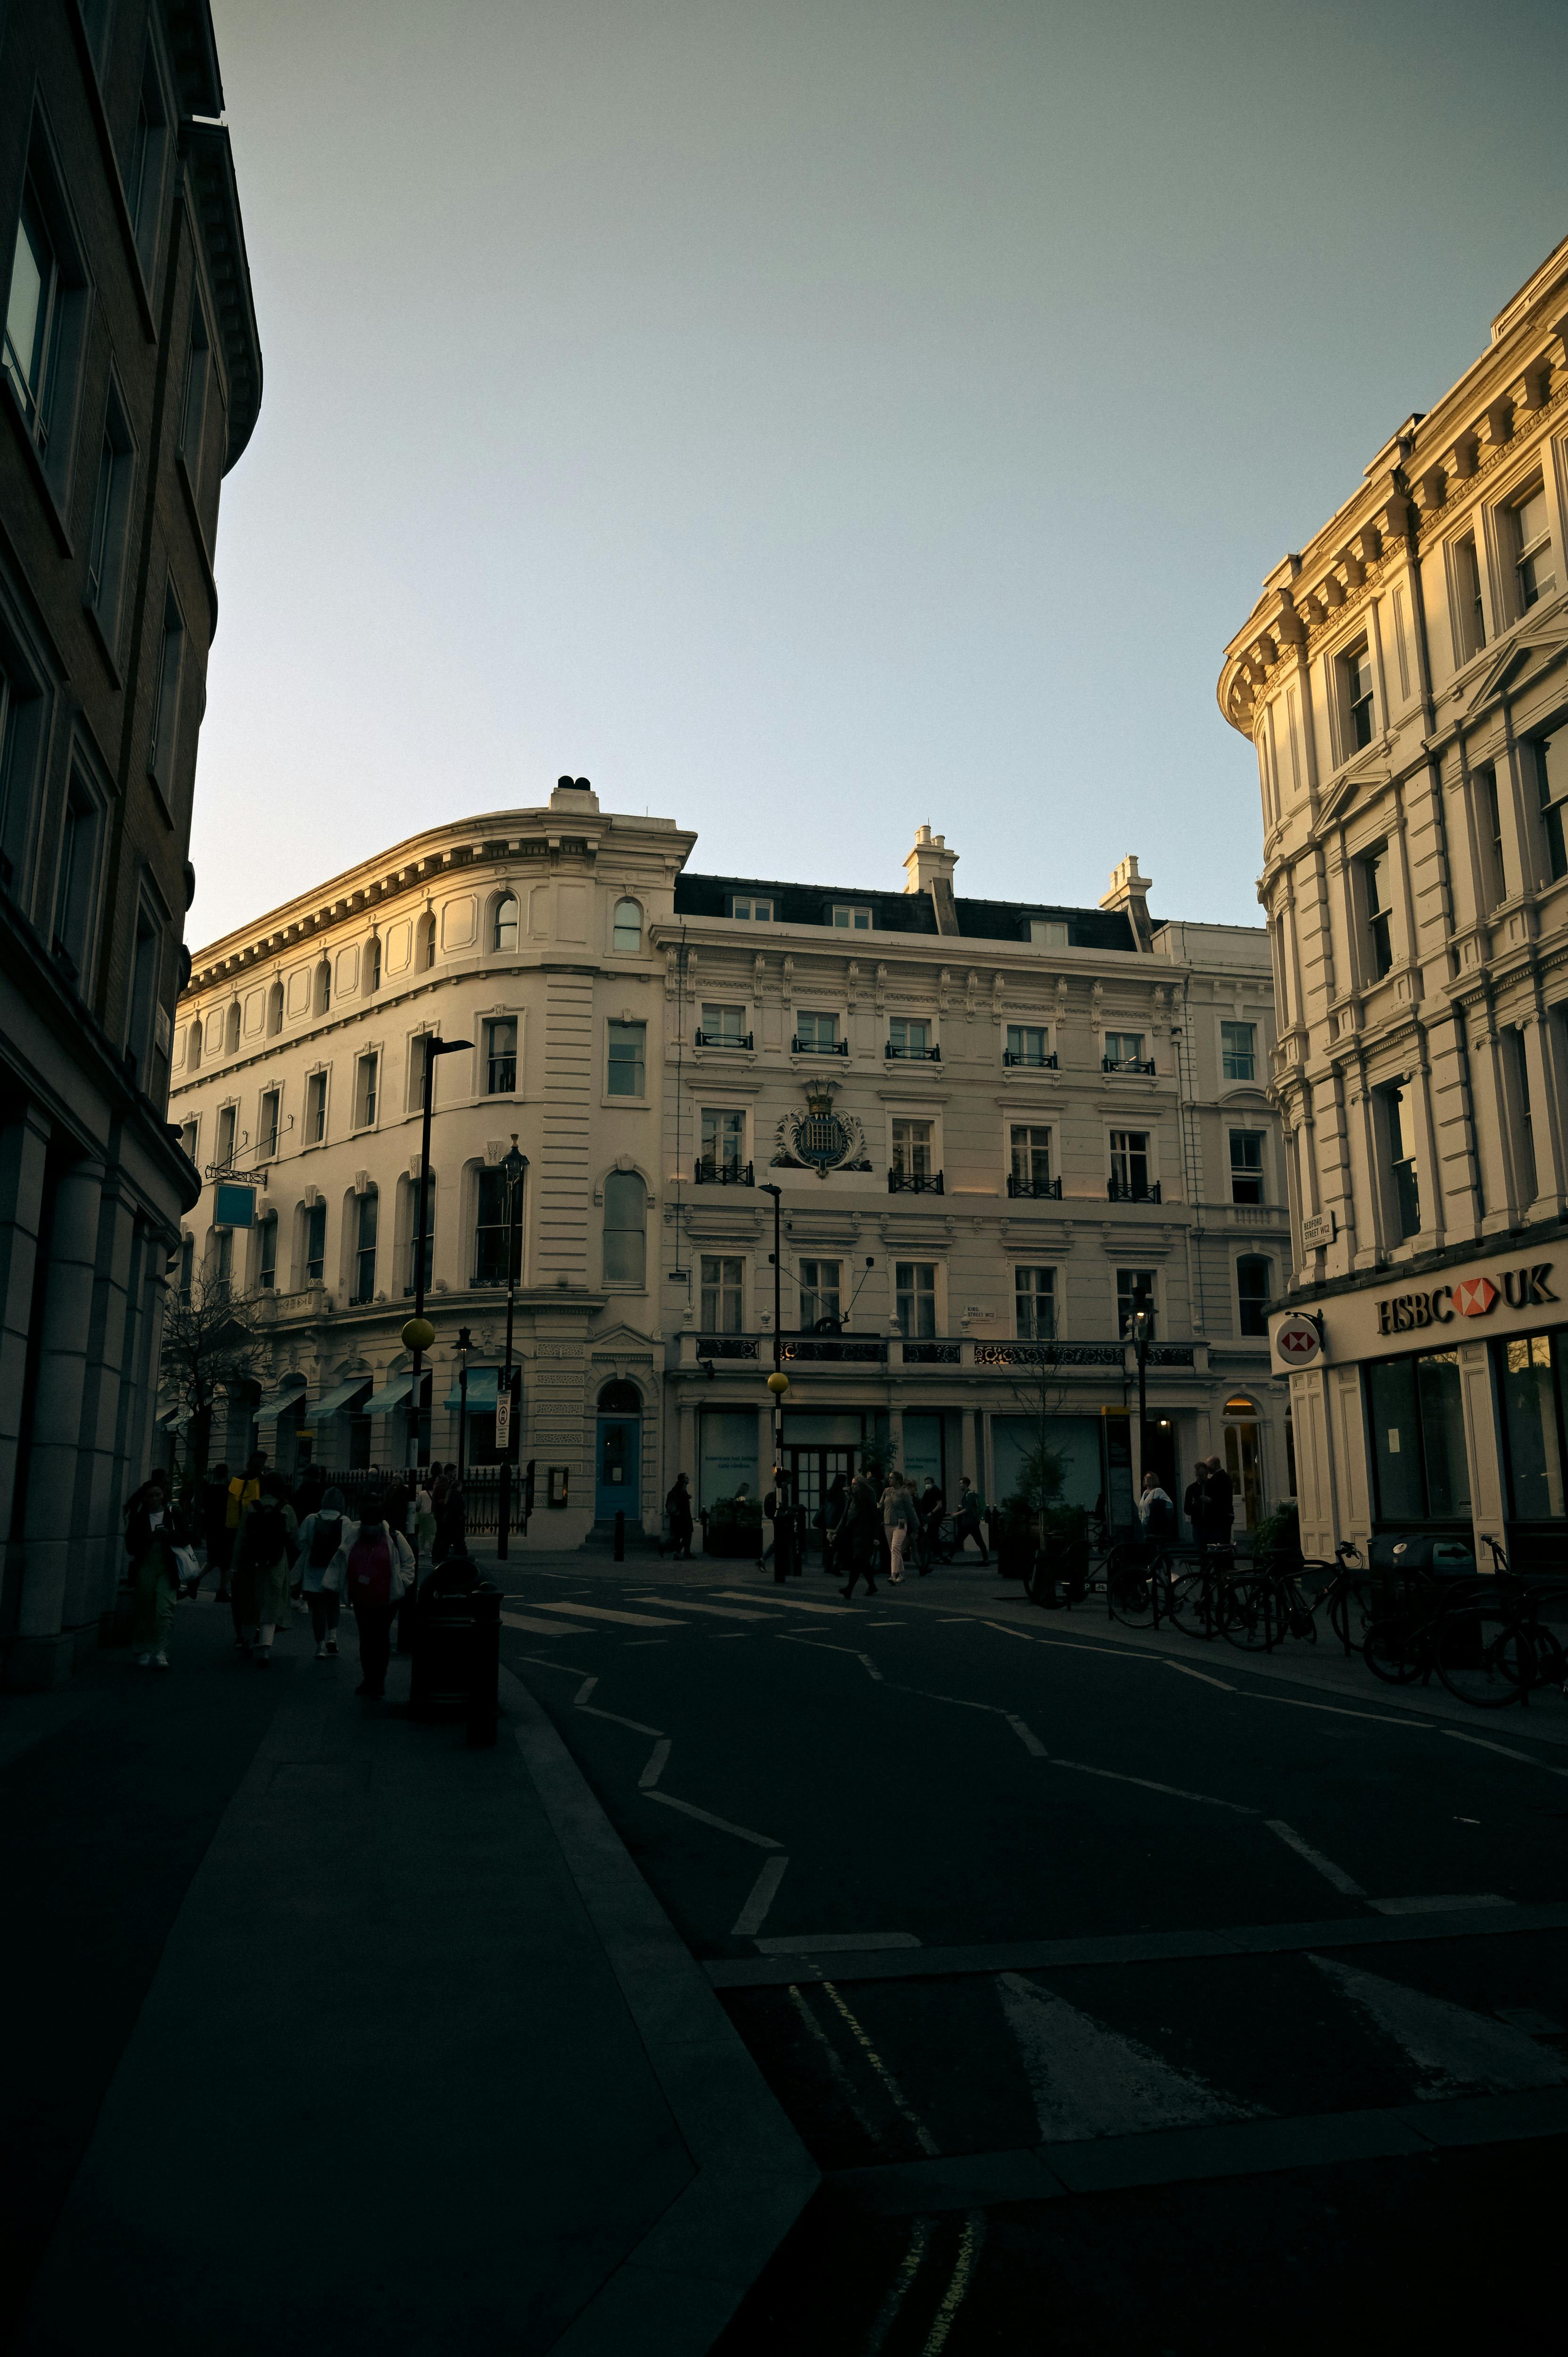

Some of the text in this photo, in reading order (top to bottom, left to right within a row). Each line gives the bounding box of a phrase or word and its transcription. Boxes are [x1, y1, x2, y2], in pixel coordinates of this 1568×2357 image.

[1304, 1217, 1322, 1230] BEDFORD
[1305, 1224, 1330, 1240] STREET WC2
[1375, 1263, 1559, 1334] HSBC UK
